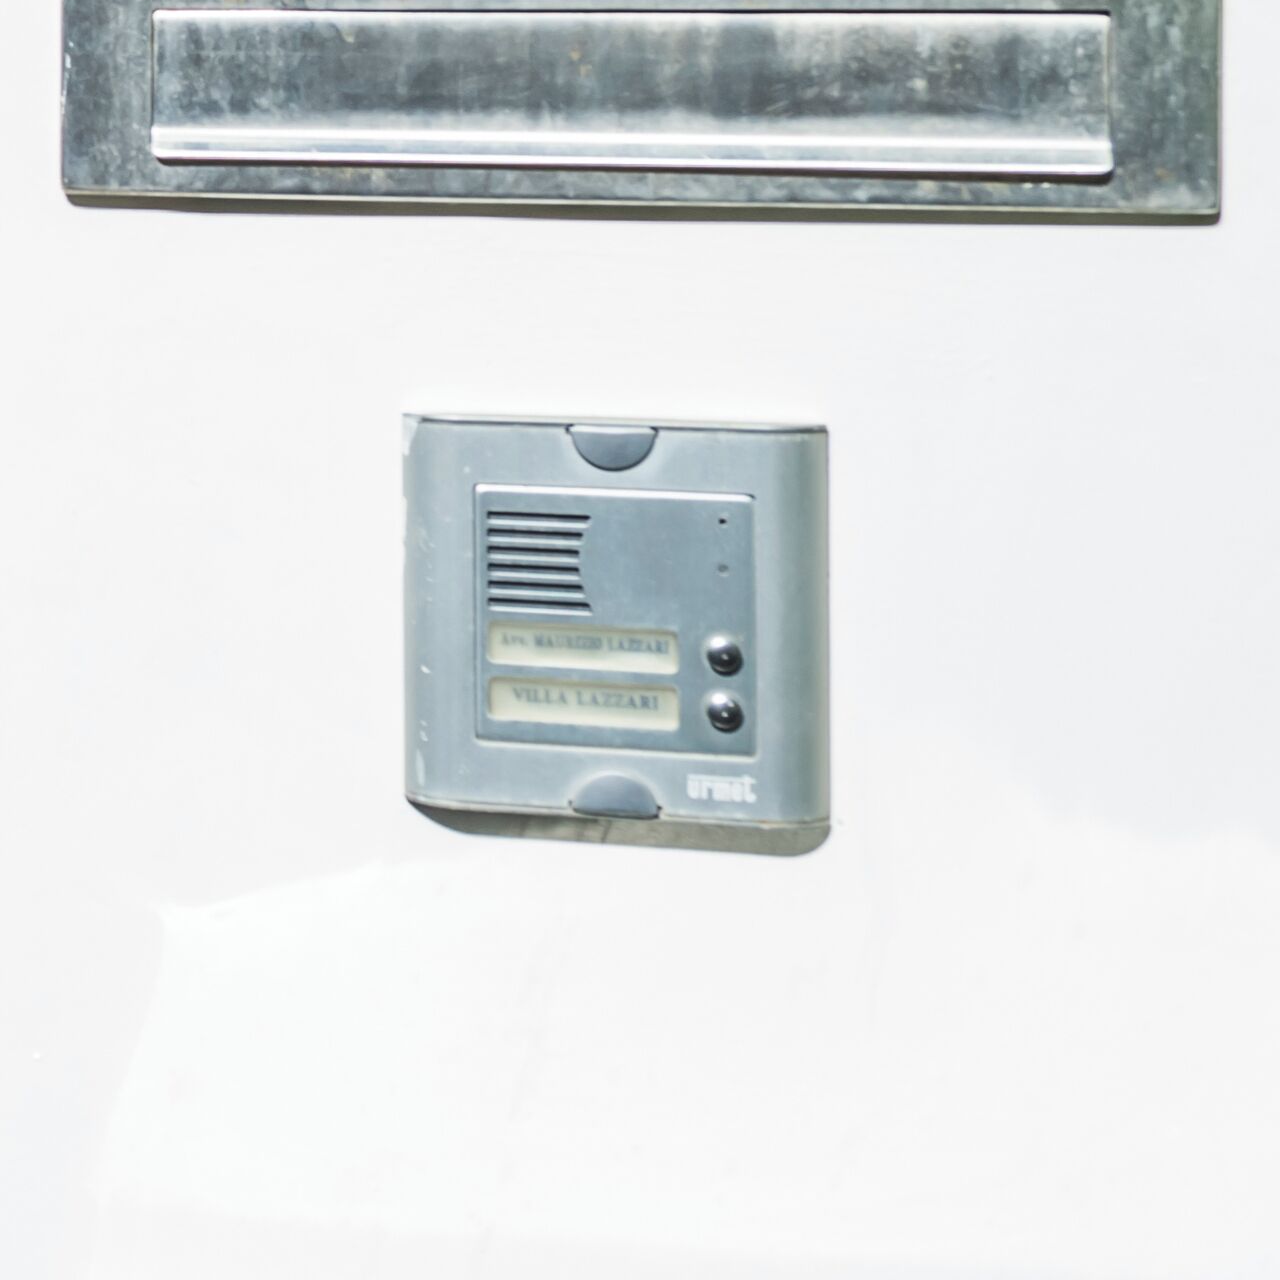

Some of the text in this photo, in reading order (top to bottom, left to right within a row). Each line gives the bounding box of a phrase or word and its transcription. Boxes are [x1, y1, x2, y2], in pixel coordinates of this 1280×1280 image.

[607, 636, 670, 654] LAZZARI
[513, 687, 659, 711] VILLA LAZZARI
